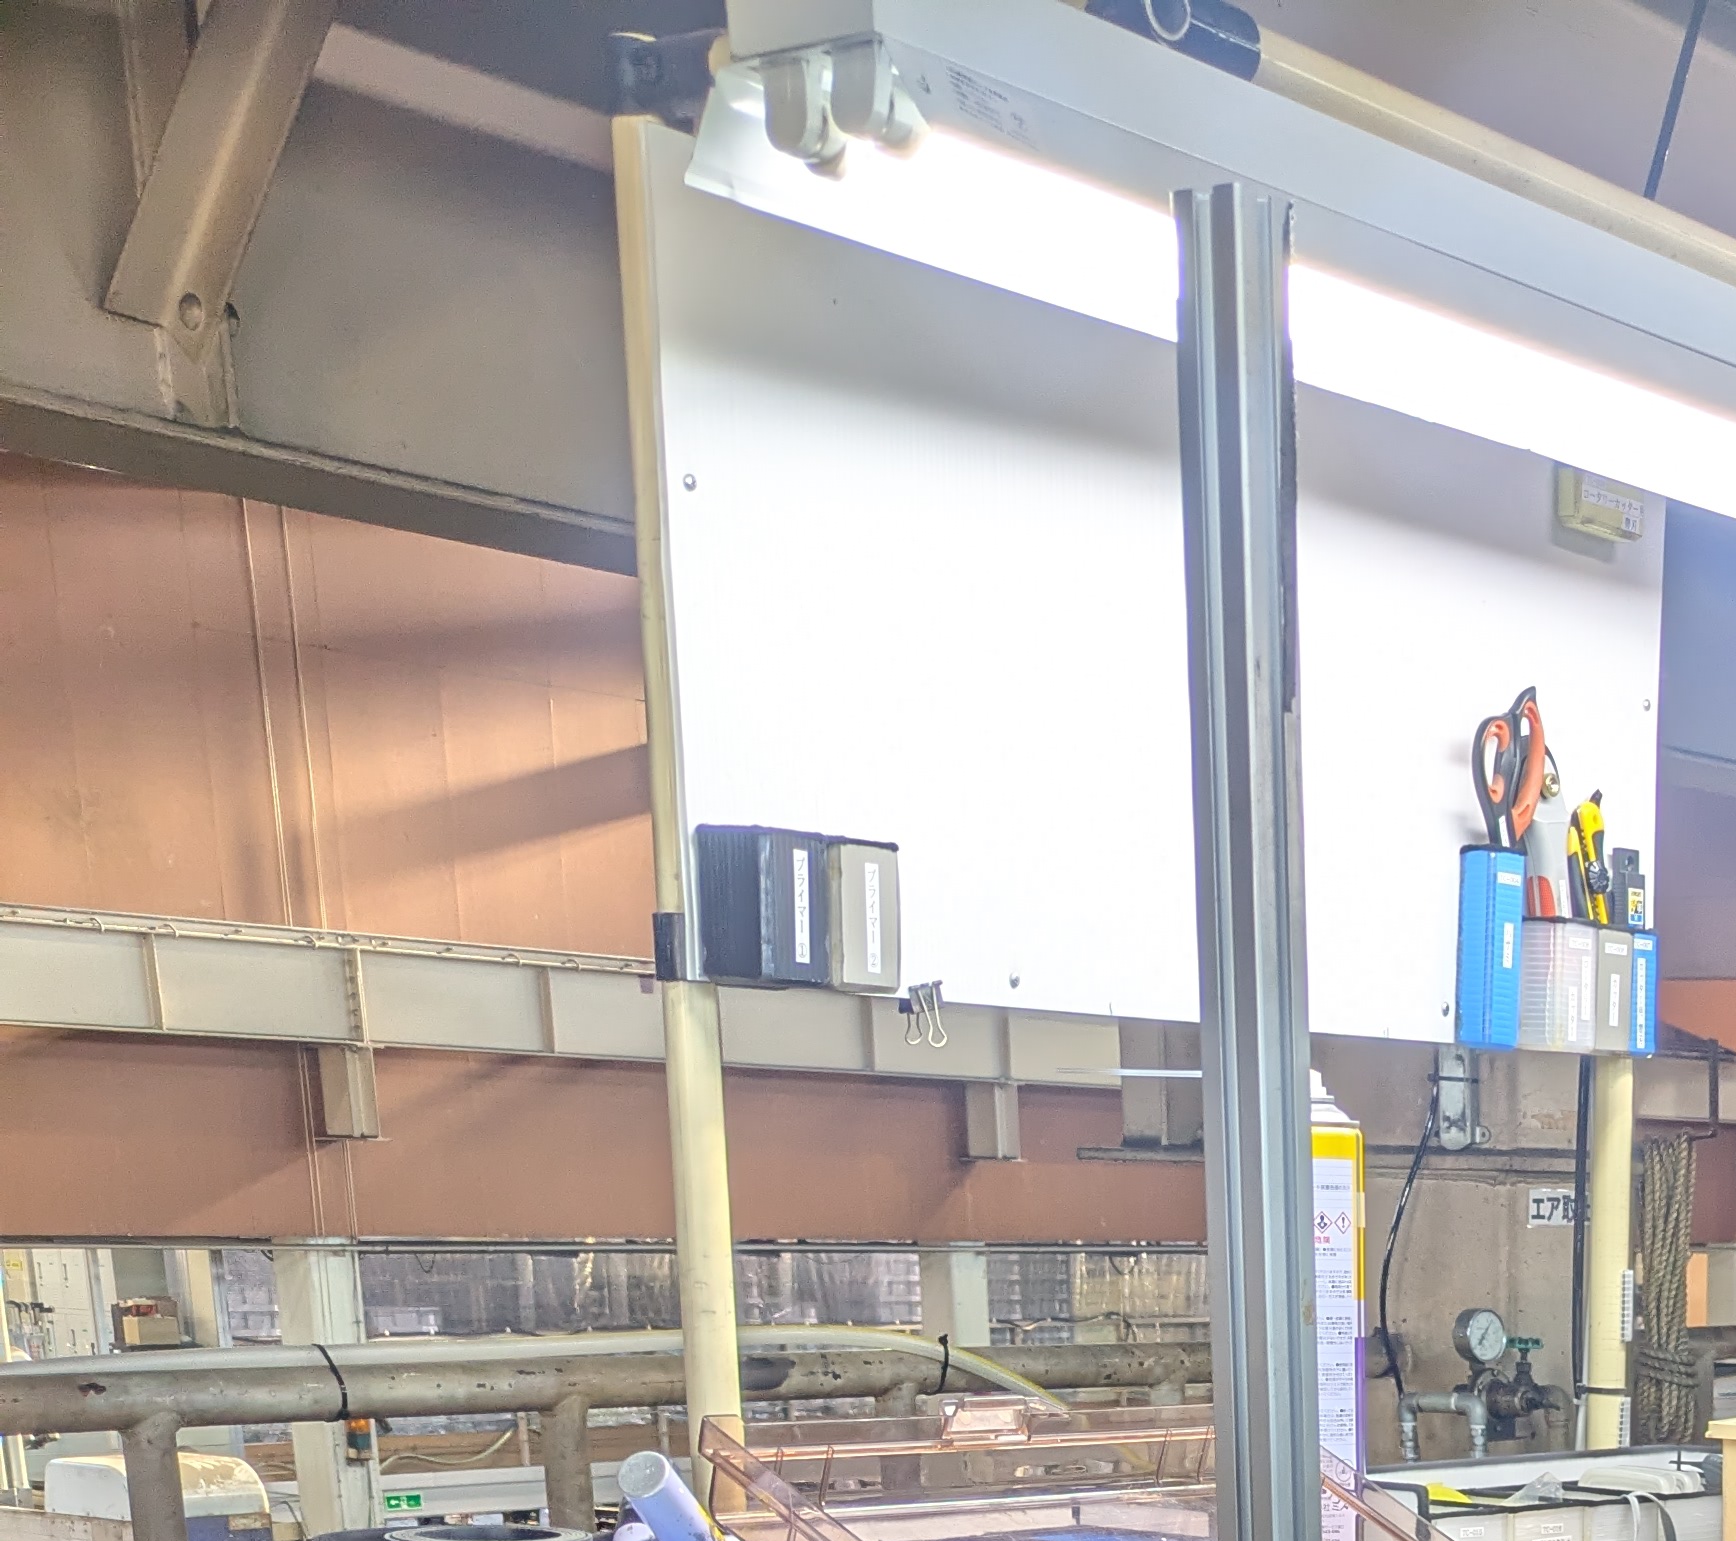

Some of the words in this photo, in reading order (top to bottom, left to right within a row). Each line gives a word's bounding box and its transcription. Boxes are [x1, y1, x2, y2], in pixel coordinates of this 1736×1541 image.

[796, 857, 806, 933] プライマー
[867, 869, 878, 944] プライマー
